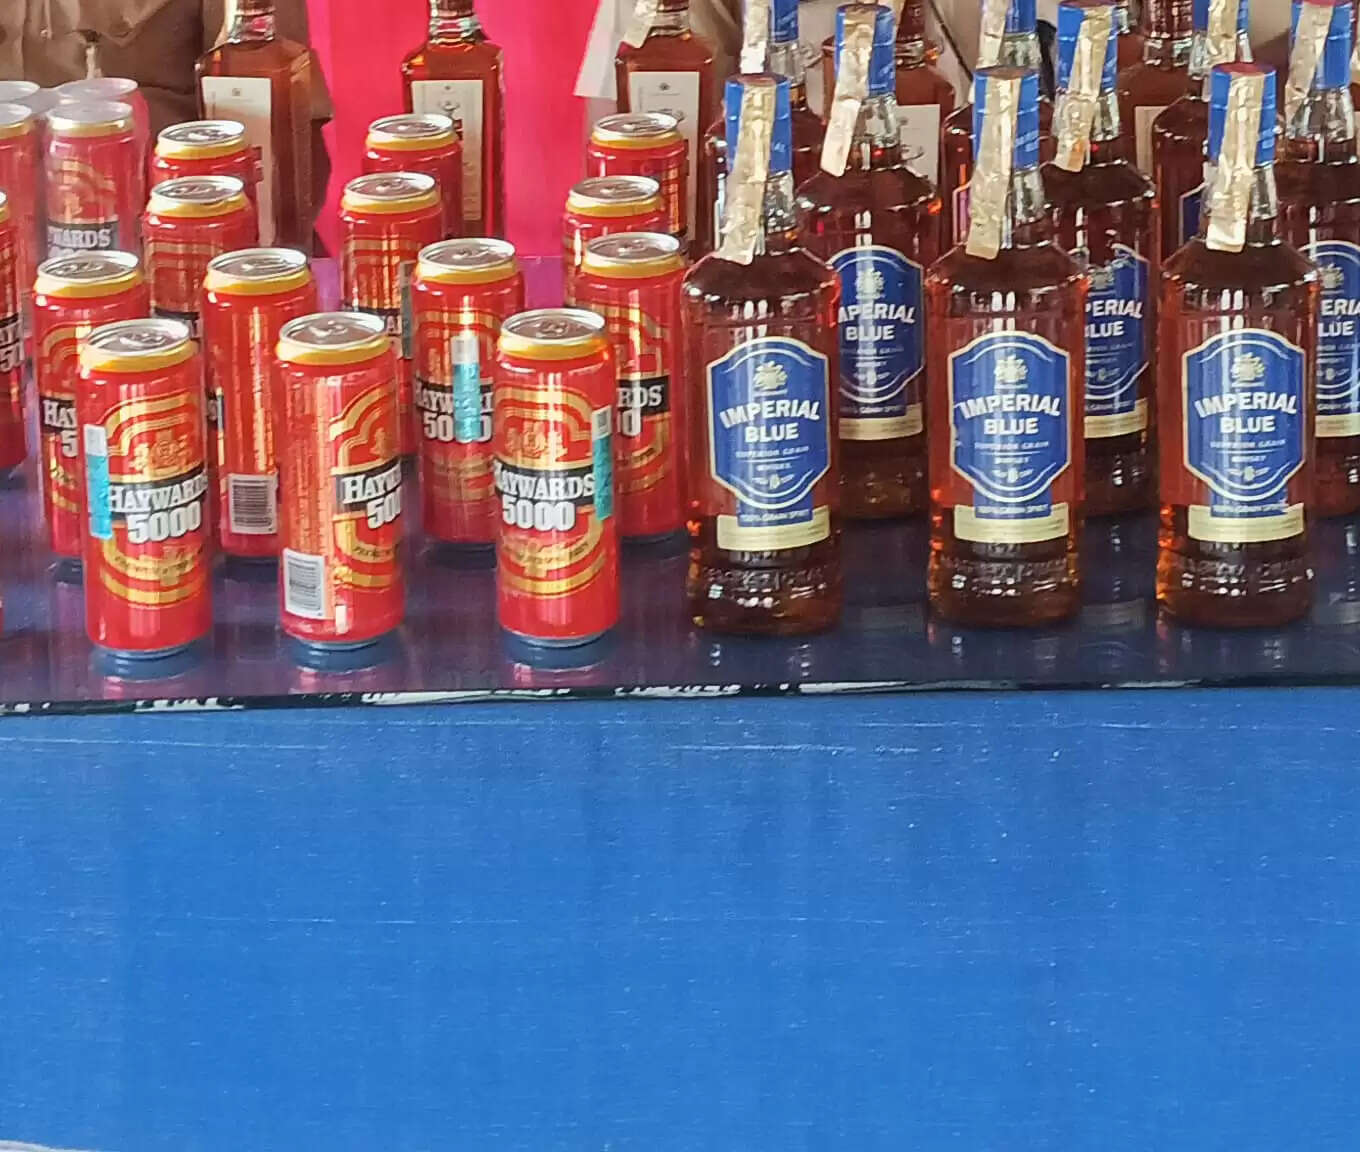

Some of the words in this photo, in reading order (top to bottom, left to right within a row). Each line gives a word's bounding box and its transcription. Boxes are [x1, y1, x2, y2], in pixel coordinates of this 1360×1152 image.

[845, 325, 896, 341] BLUE
[719, 399, 821, 428] IMPERIAL
[959, 393, 1061, 420] IMPERIAL
[1194, 391, 1298, 418] IMPERIAL
[744, 422, 800, 443] BLUE
[983, 417, 1040, 436] BLUE
[1219, 415, 1276, 434] BLUE
[126, 500, 202, 545] 5000
[502, 493, 576, 532] 5000
